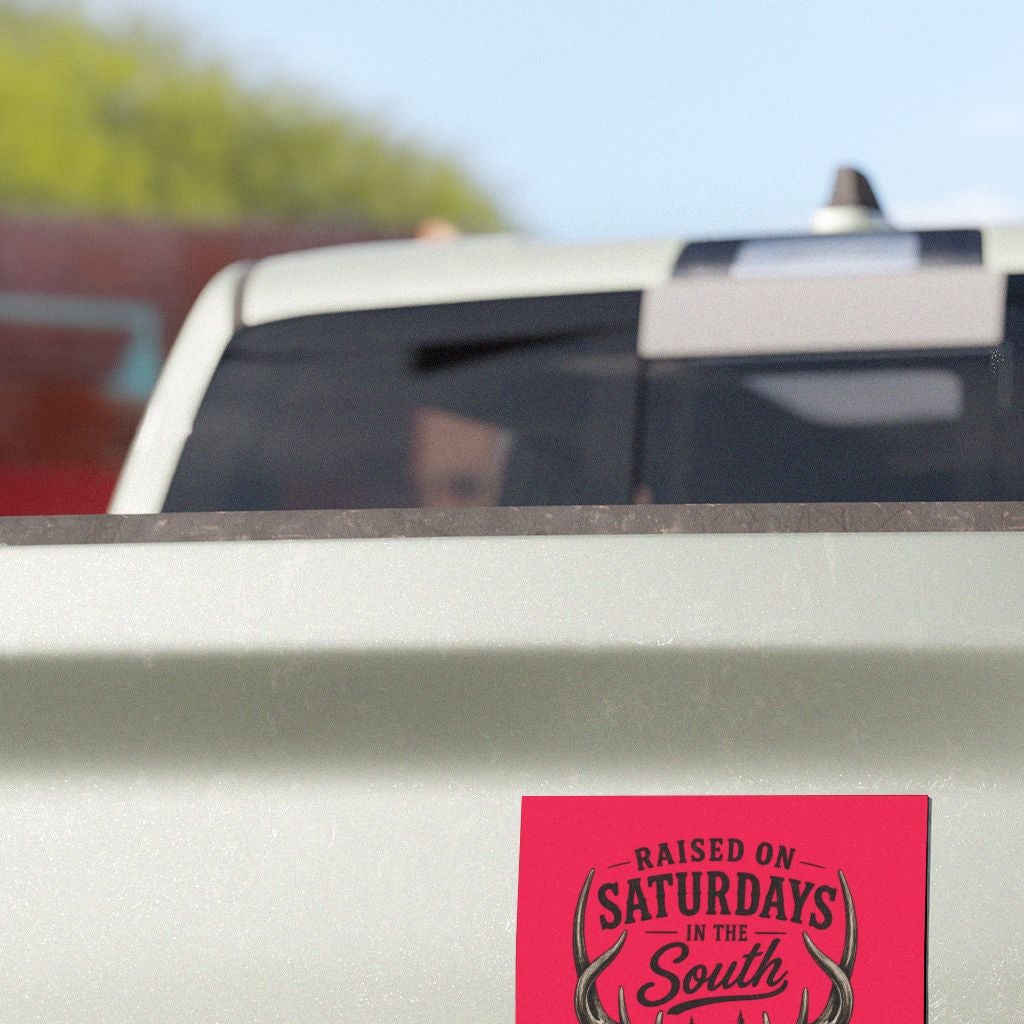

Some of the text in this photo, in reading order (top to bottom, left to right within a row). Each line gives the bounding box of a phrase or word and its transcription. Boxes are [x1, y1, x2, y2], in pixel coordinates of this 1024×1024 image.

[635, 838, 796, 870] RAISED ON
[597, 870, 837, 930] SATURDAYS
[686, 924, 748, 942] IN THE
[636, 938, 789, 1014] South
